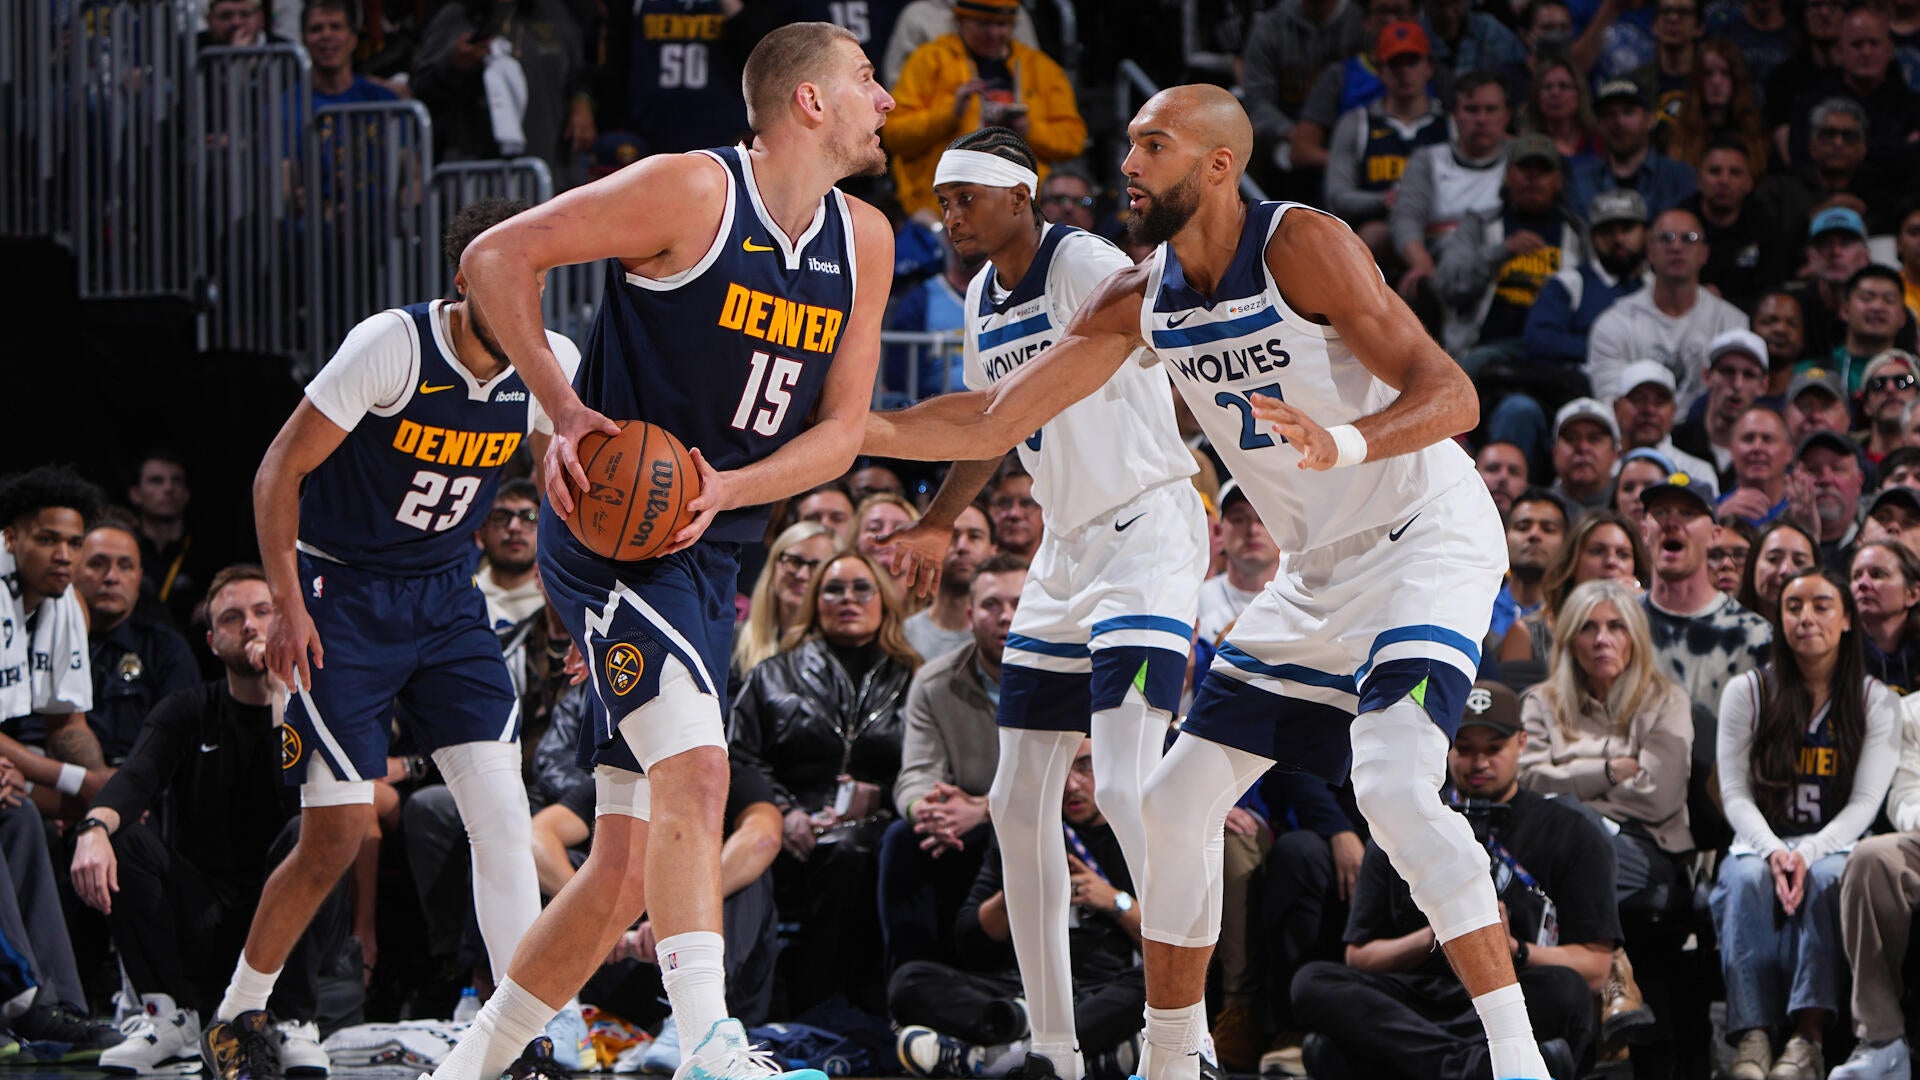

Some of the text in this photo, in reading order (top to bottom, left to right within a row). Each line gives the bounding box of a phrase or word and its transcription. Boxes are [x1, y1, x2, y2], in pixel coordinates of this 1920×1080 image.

[659, 43, 709, 90] 50
[808, 257, 841, 276] ibotta
[717, 281, 844, 355] DENVER
[1170, 338, 1291, 384] WOLVES
[495, 390, 527, 403] ibotta
[730, 350, 805, 437] 15
[391, 418, 523, 468] DENVER
[394, 470, 483, 532] 23
[628, 459, 674, 548] Wilson
[1787, 783, 1822, 824] 5
